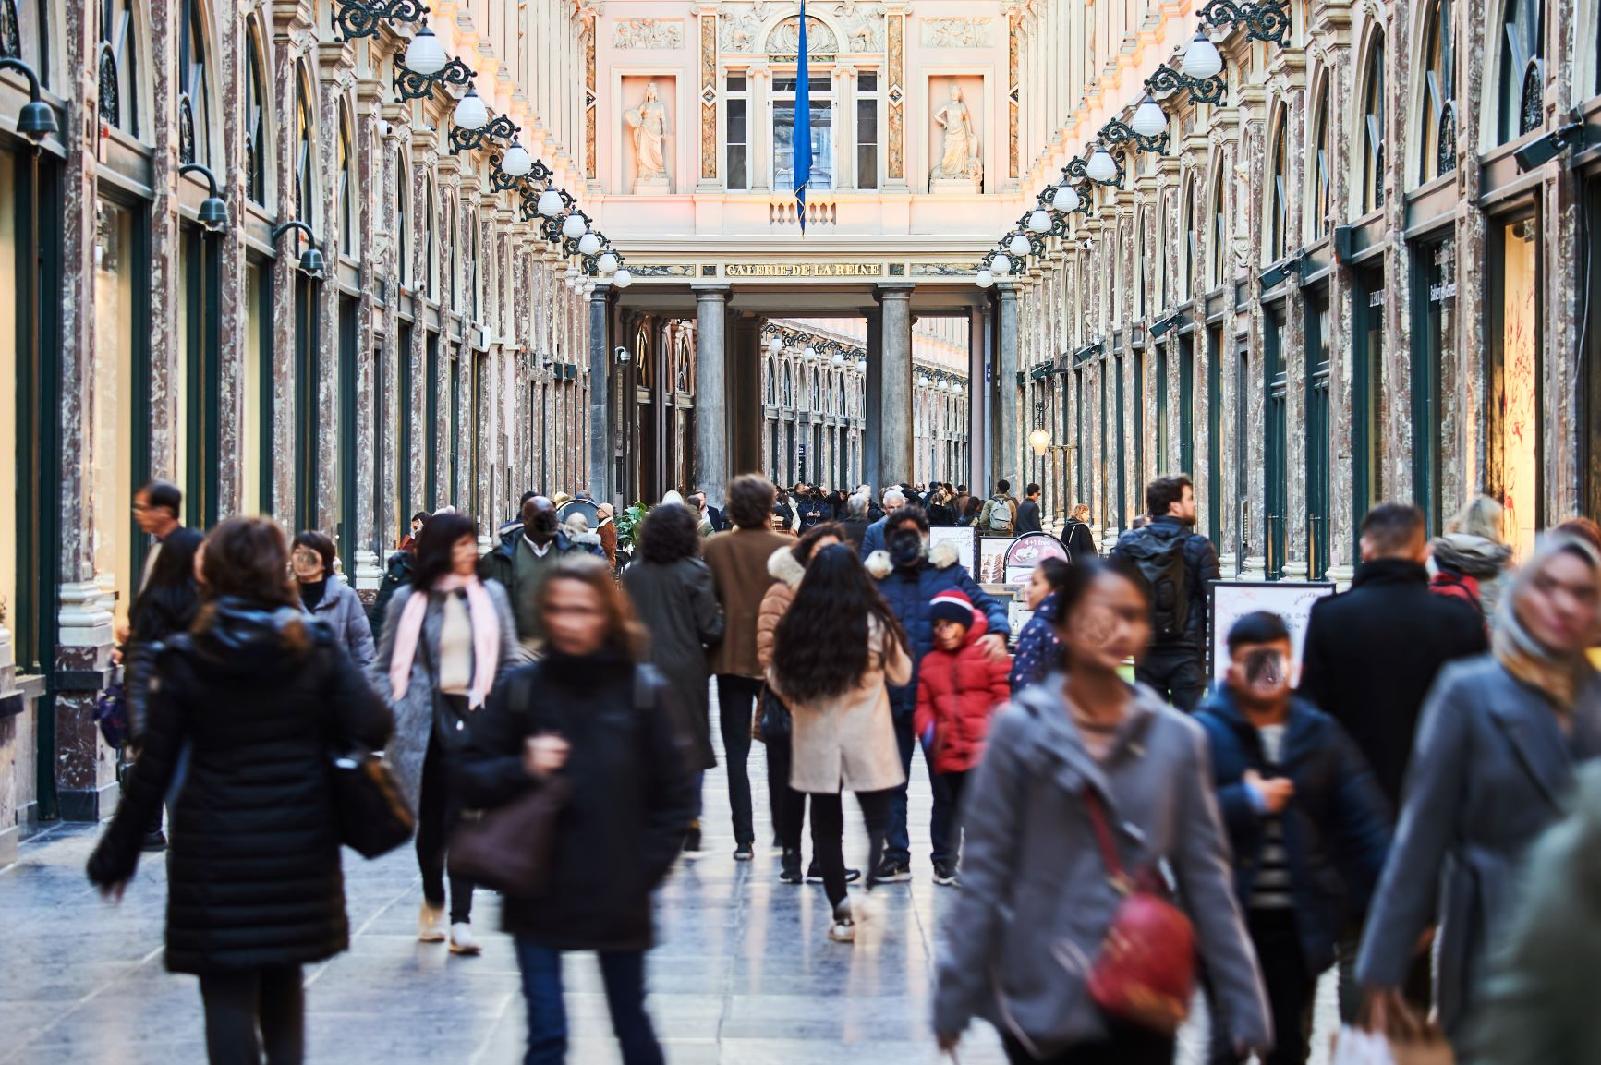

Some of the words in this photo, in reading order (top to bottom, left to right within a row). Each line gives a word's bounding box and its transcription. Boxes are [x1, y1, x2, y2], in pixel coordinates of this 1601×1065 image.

[726, 264, 786, 276] GALERIE
[792, 264, 810, 276] DE
[814, 264, 832, 276] LA
[835, 263, 880, 276] REINE
